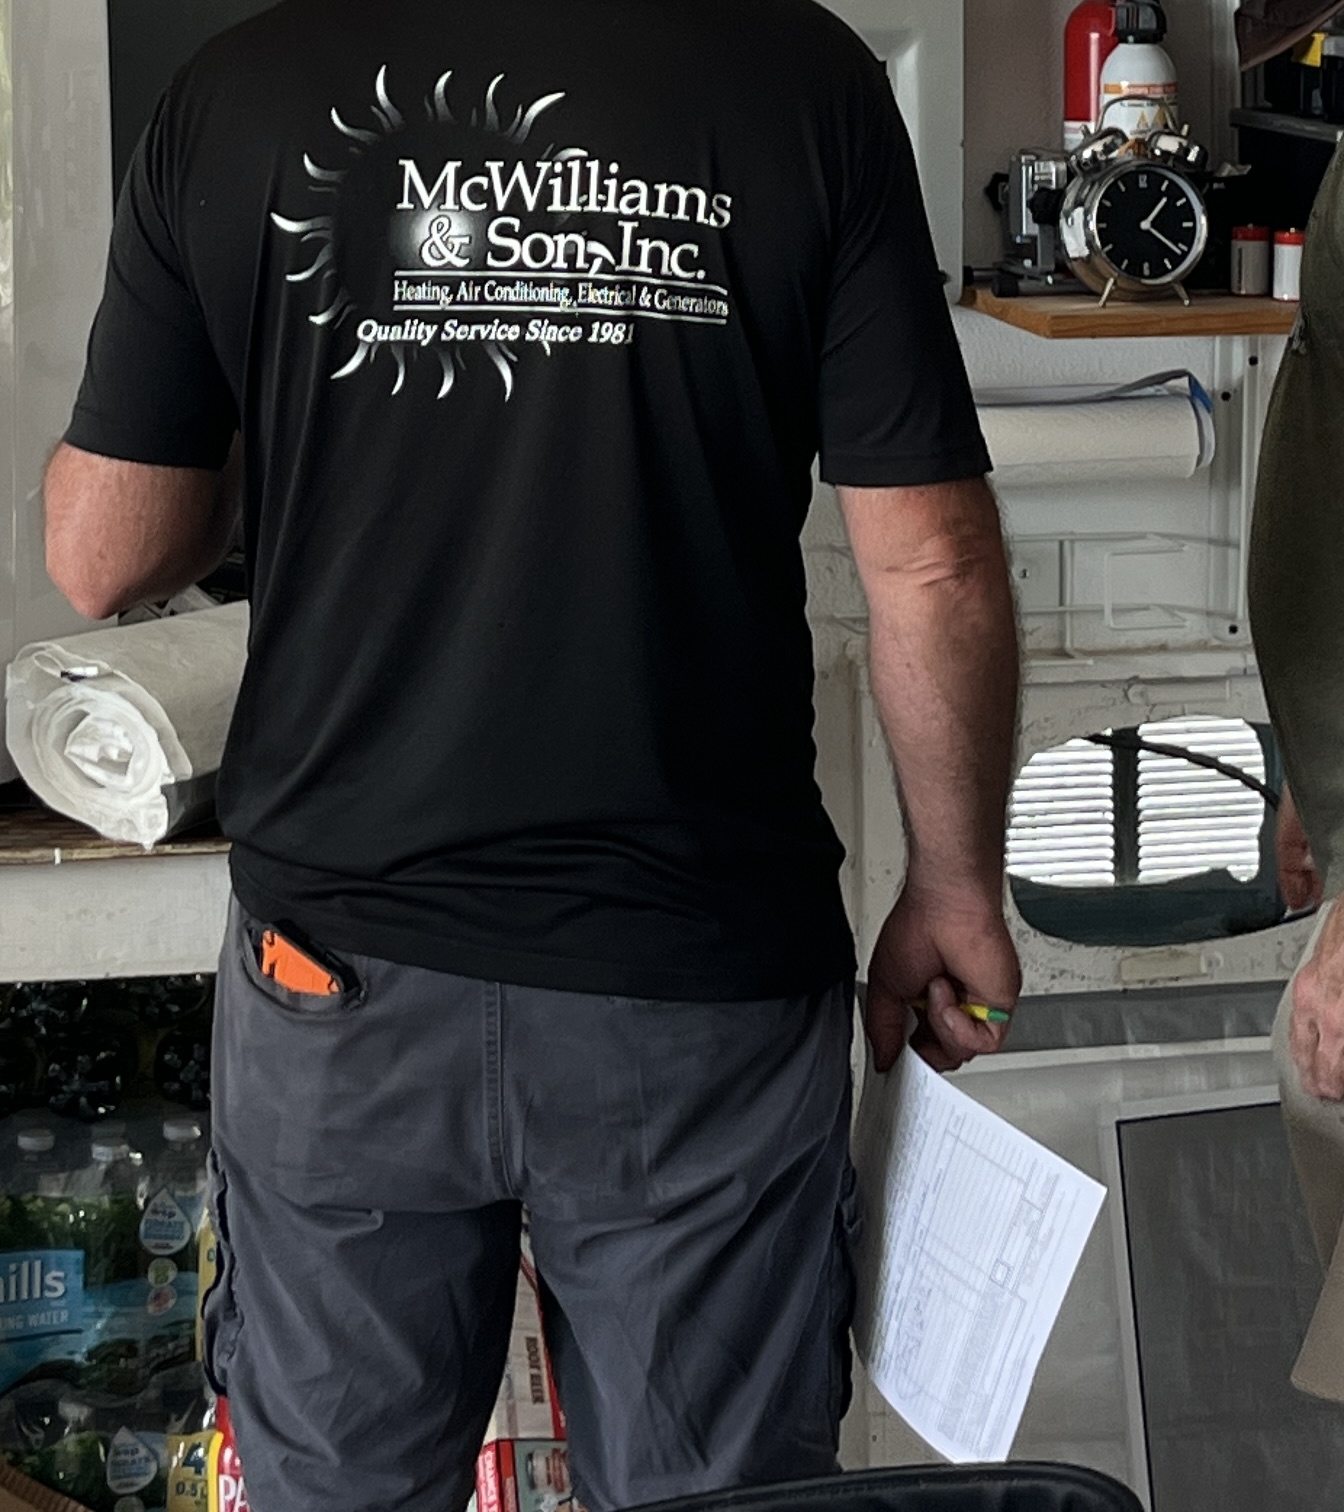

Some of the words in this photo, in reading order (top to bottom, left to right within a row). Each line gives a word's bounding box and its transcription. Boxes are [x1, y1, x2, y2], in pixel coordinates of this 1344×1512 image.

[395, 158, 733, 229] McWilliams
[419, 214, 472, 268] &
[485, 215, 604, 277] Son,
[613, 220, 707, 280] Inc.
[392, 280, 454, 310] Heating,
[456, 280, 482, 301] Air
[576, 282, 637, 307] Electrical
[638, 285, 653, 309] &
[654, 288, 730, 317] Generators
[356, 319, 438, 347] Quality
[440, 319, 521, 342] Service
[524, 318, 584, 342] Since
[587, 321, 635, 345] 1981
[27, 1309, 70, 1329] WATER
